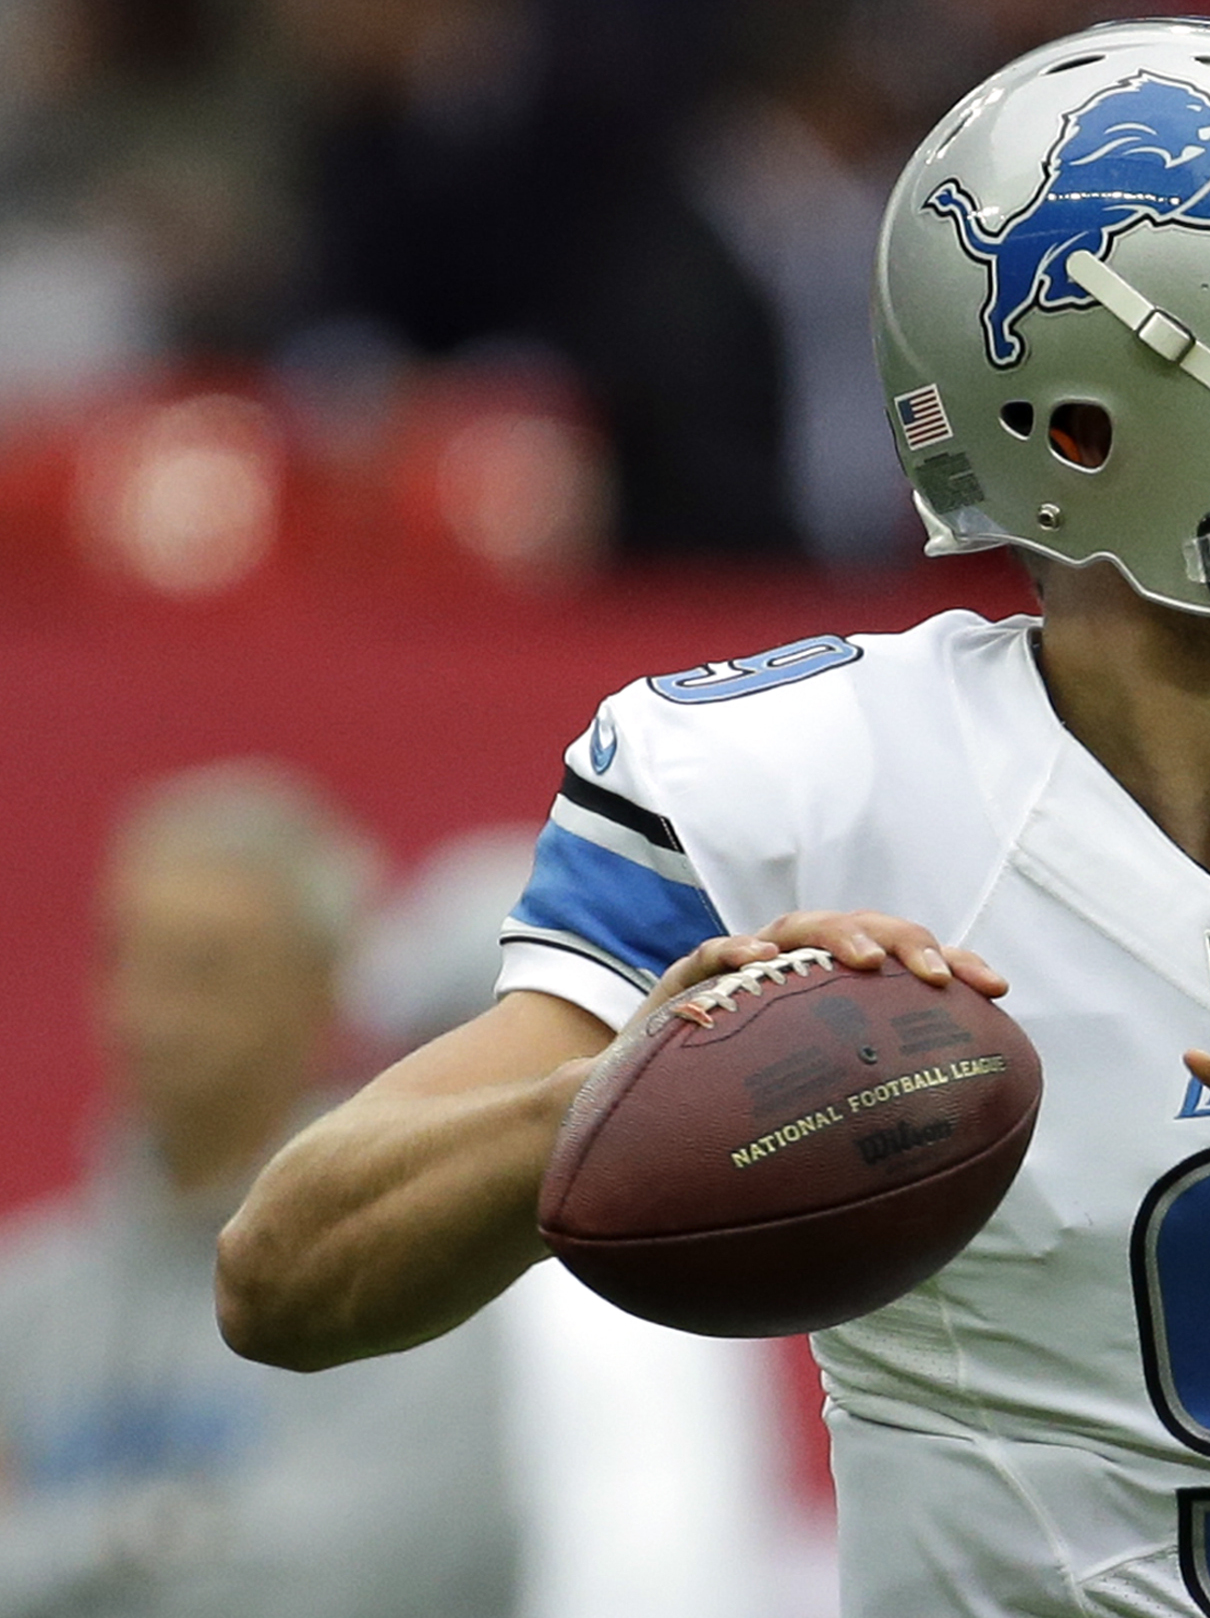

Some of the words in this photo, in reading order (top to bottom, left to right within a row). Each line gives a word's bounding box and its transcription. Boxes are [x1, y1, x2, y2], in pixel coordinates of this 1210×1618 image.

[646, 633, 864, 705] 9
[730, 1105, 844, 1169] NATIONAL
[848, 1067, 949, 1113] FOOTBALL
[950, 1055, 1007, 1080] LEAGUE
[855, 1119, 955, 1165] Wilson
